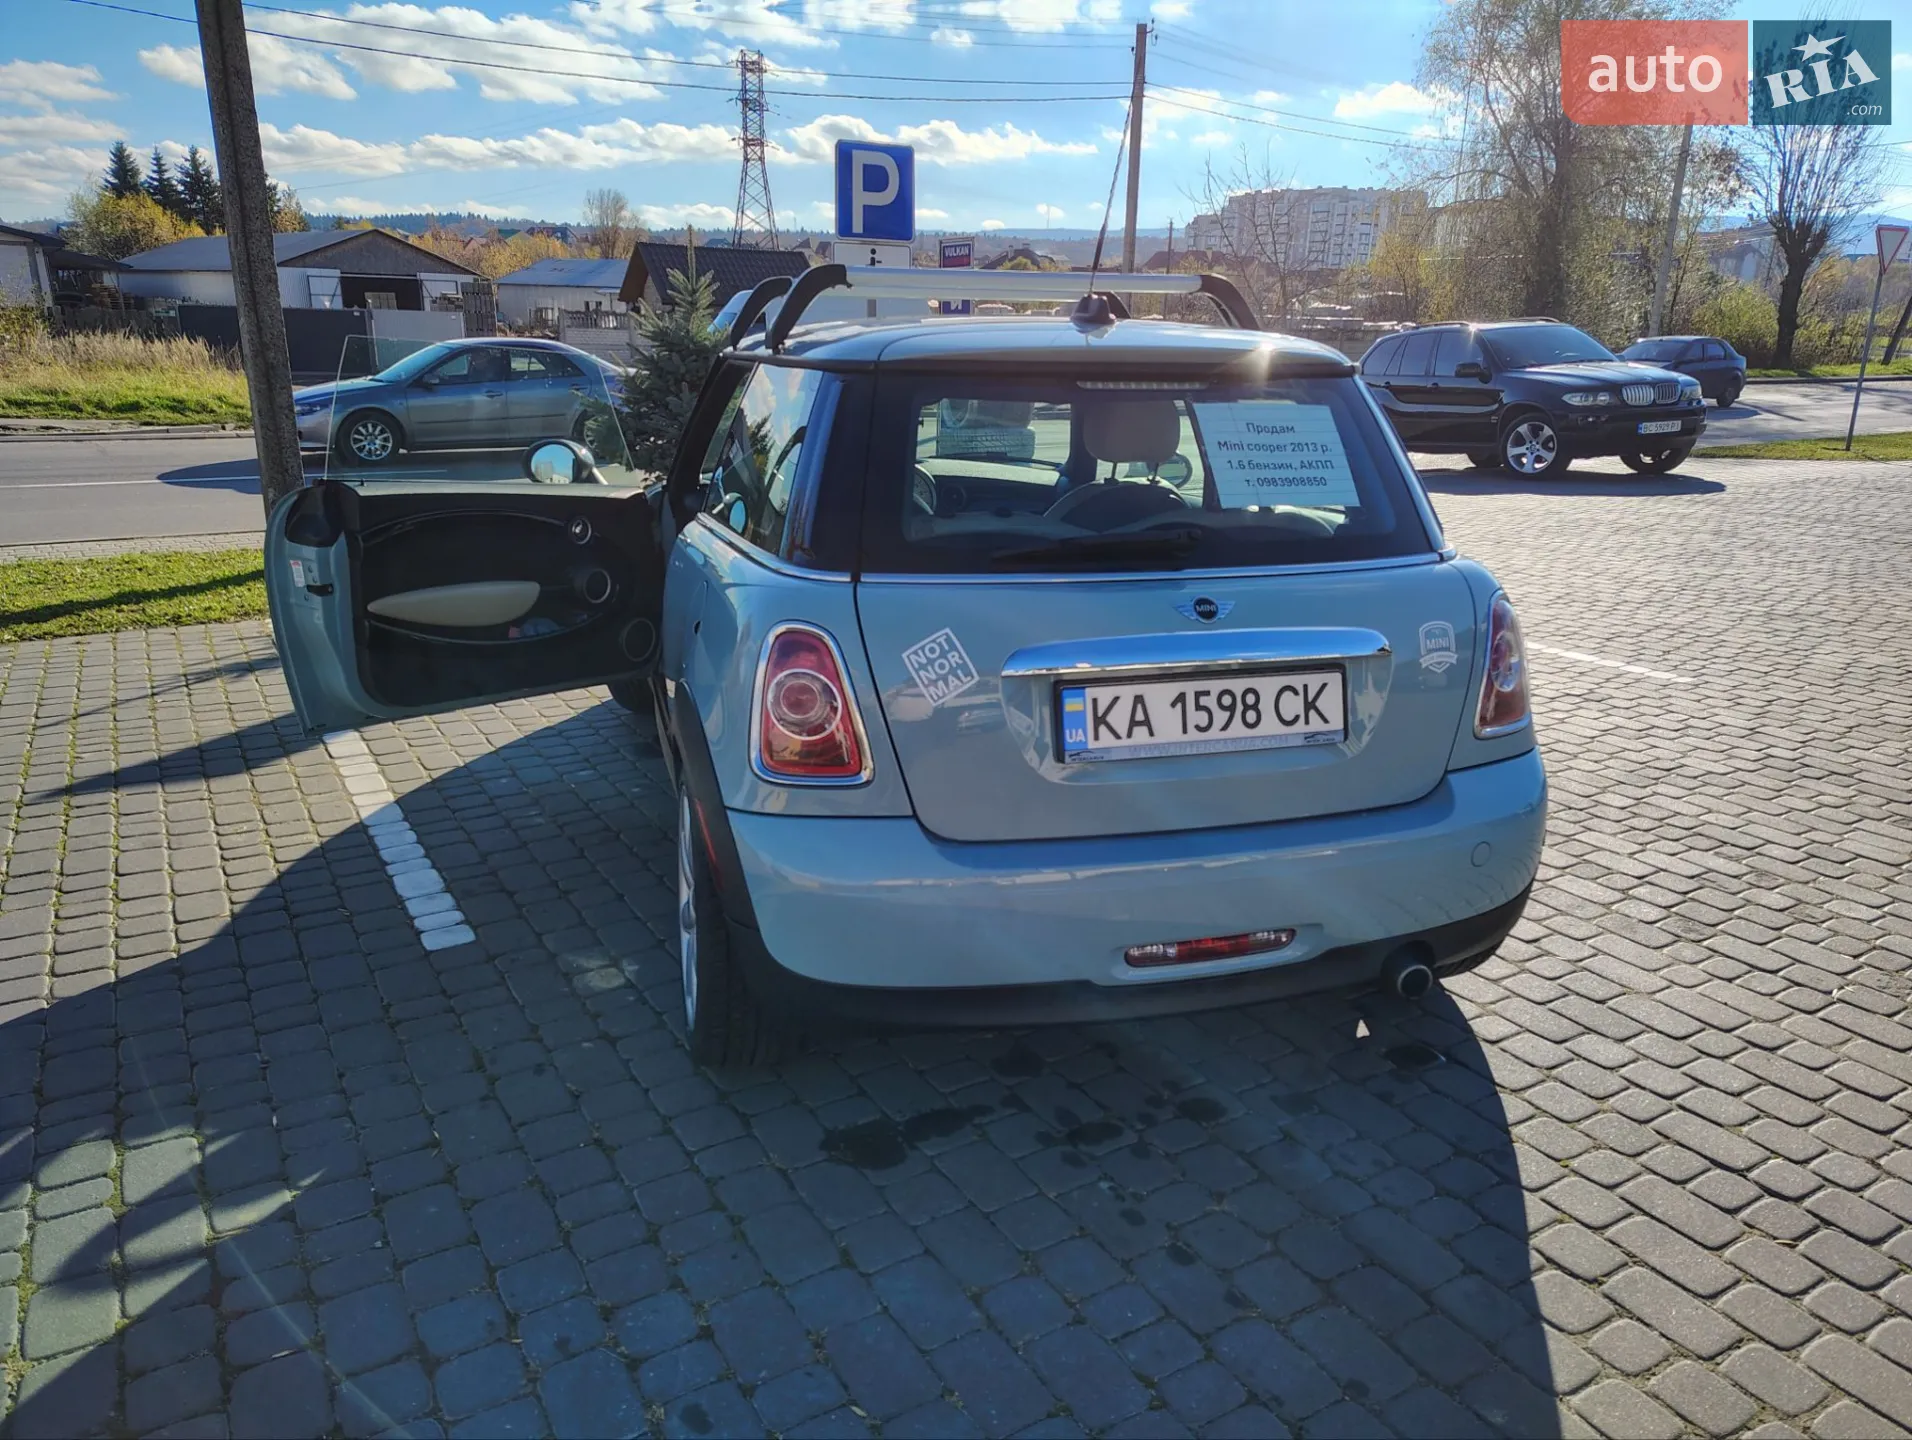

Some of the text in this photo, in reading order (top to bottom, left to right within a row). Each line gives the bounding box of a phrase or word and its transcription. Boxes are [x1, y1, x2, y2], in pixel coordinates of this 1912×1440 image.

[851, 149, 900, 234] P
[944, 245, 969, 257] VULKAN
[1246, 422, 1295, 436] Продам
[1217, 440, 1245, 451] Mini
[1247, 443, 1288, 454] cooper
[1290, 442, 1318, 453] 2013
[1227, 459, 1334, 472] 1.6 бензин, АКПП
[1257, 476, 1327, 488] 0983908850
[1196, 604, 1217, 613] MINI
[1426, 637, 1449, 650] MINI
[908, 634, 949, 669] NOT
[918, 651, 963, 685] NOR
[928, 669, 972, 701] MAL
[1091, 682, 1330, 741] KA 1598 CK
[1065, 729, 1086, 743] UA
